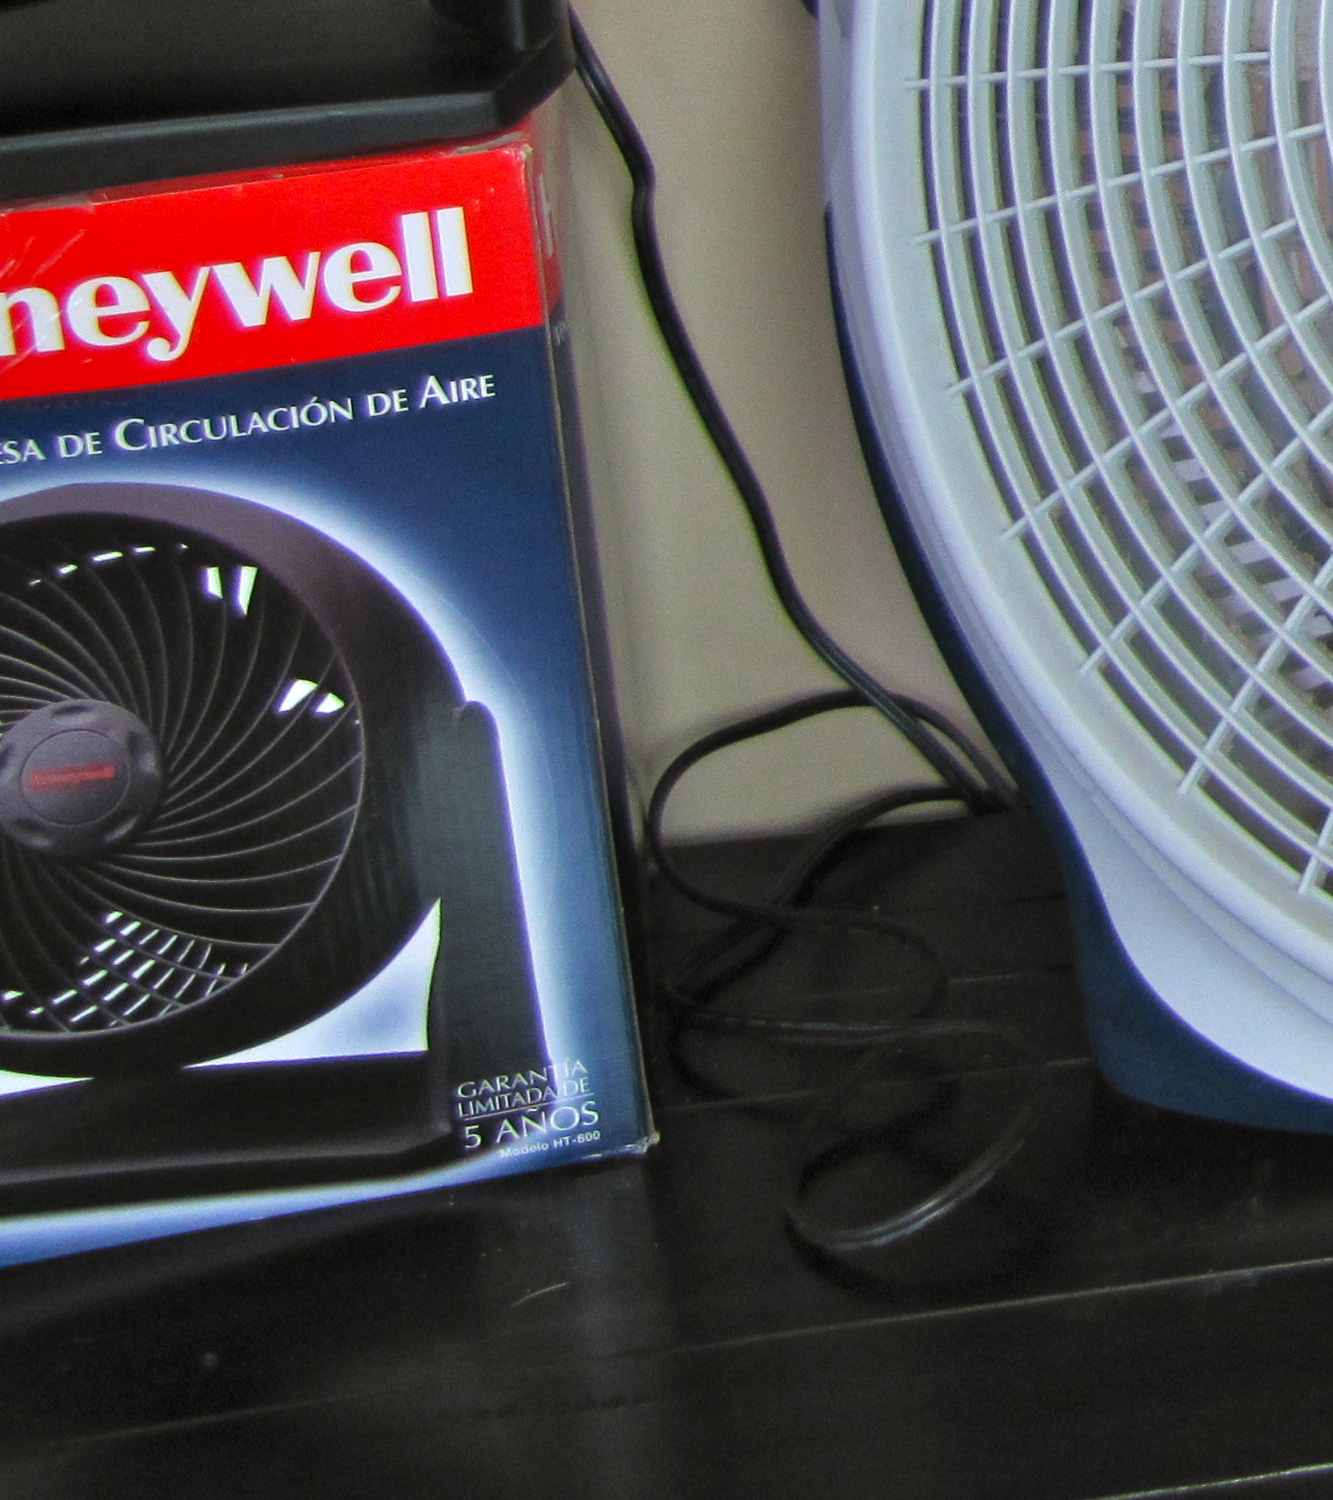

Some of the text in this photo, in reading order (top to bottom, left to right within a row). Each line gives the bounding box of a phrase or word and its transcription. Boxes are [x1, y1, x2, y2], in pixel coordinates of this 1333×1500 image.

[0, 375, 496, 464] SA DE CIRCULACIÓN DE AIRE
[458, 1077, 592, 1118] LIMITADA DE
[464, 1100, 599, 1149] 5 AÑOS
